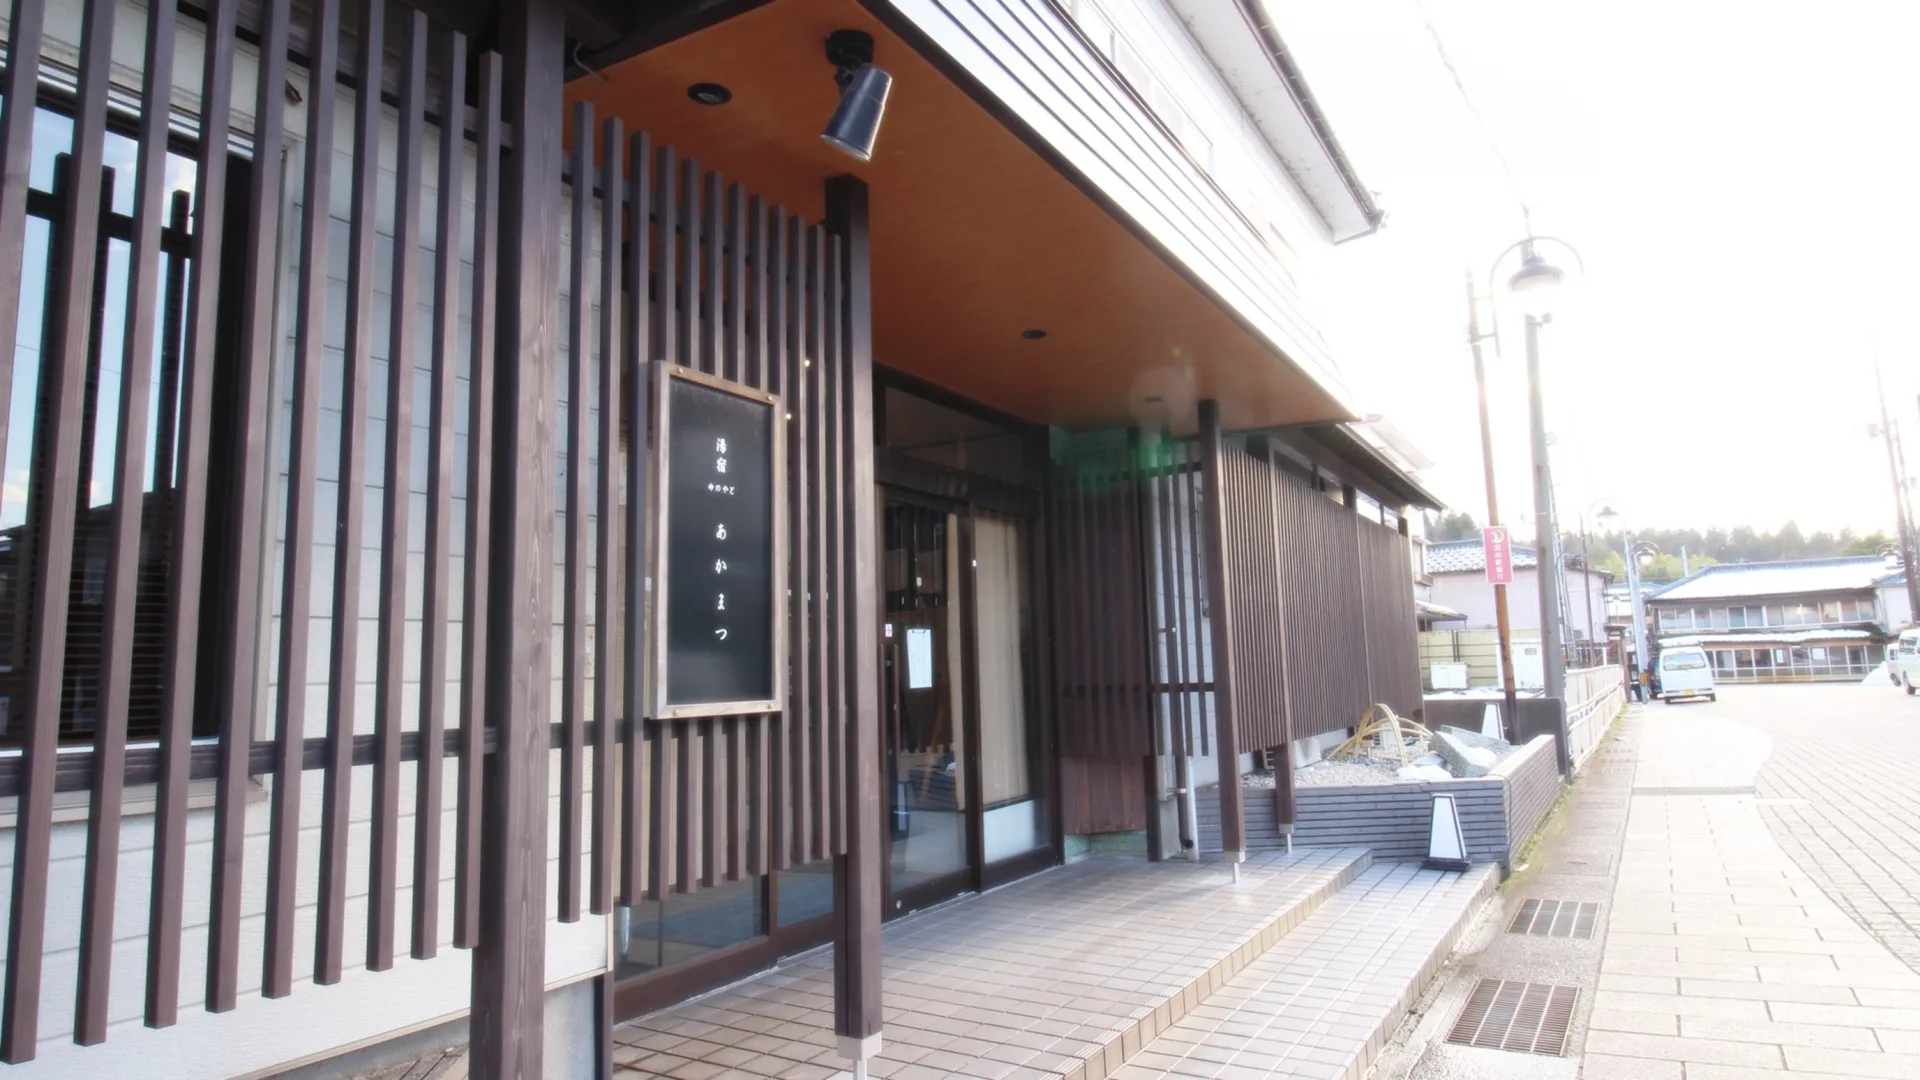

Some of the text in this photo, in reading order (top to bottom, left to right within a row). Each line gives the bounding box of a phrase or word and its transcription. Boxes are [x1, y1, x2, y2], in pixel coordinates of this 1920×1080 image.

[715, 437, 728, 474] 湯宿
[714, 523, 728, 641] あかまつ
